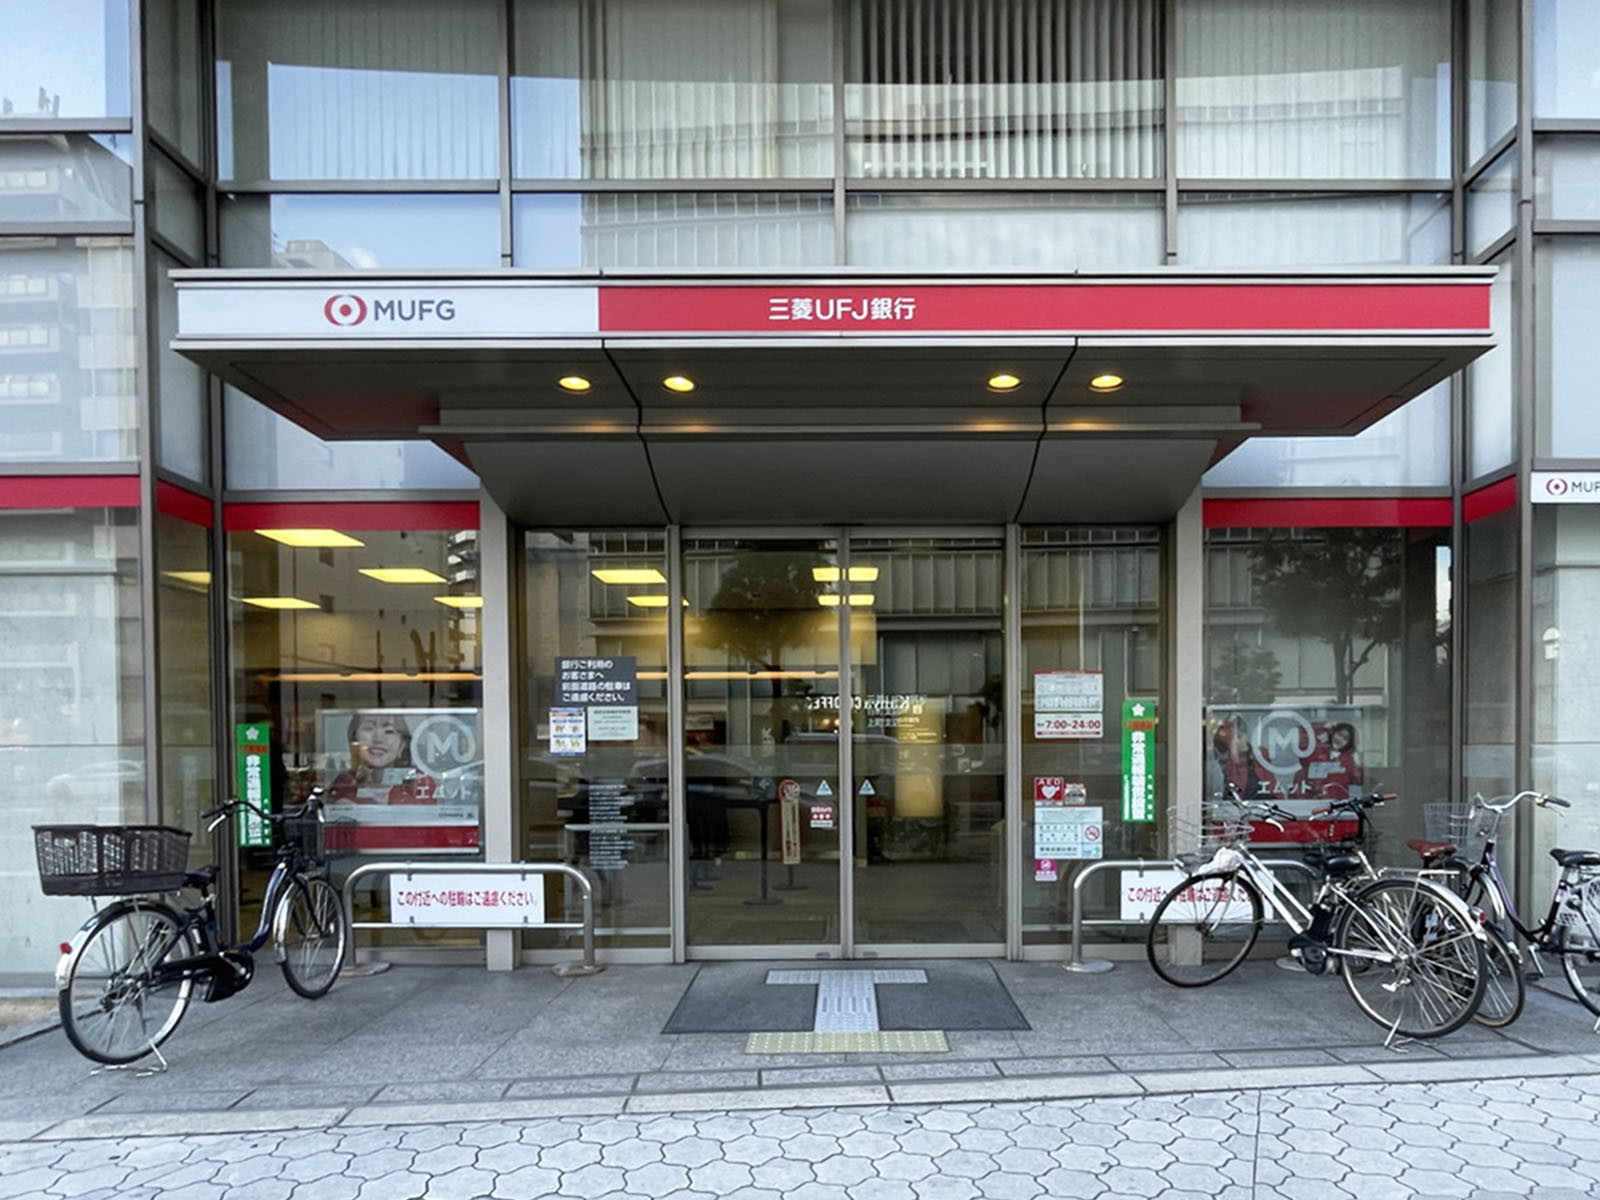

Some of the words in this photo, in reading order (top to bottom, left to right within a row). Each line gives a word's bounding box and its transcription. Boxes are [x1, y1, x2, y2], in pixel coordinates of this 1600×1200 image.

[374, 300, 455, 321] MUFG
[768, 298, 916, 320] 三菱UFJ銀行
